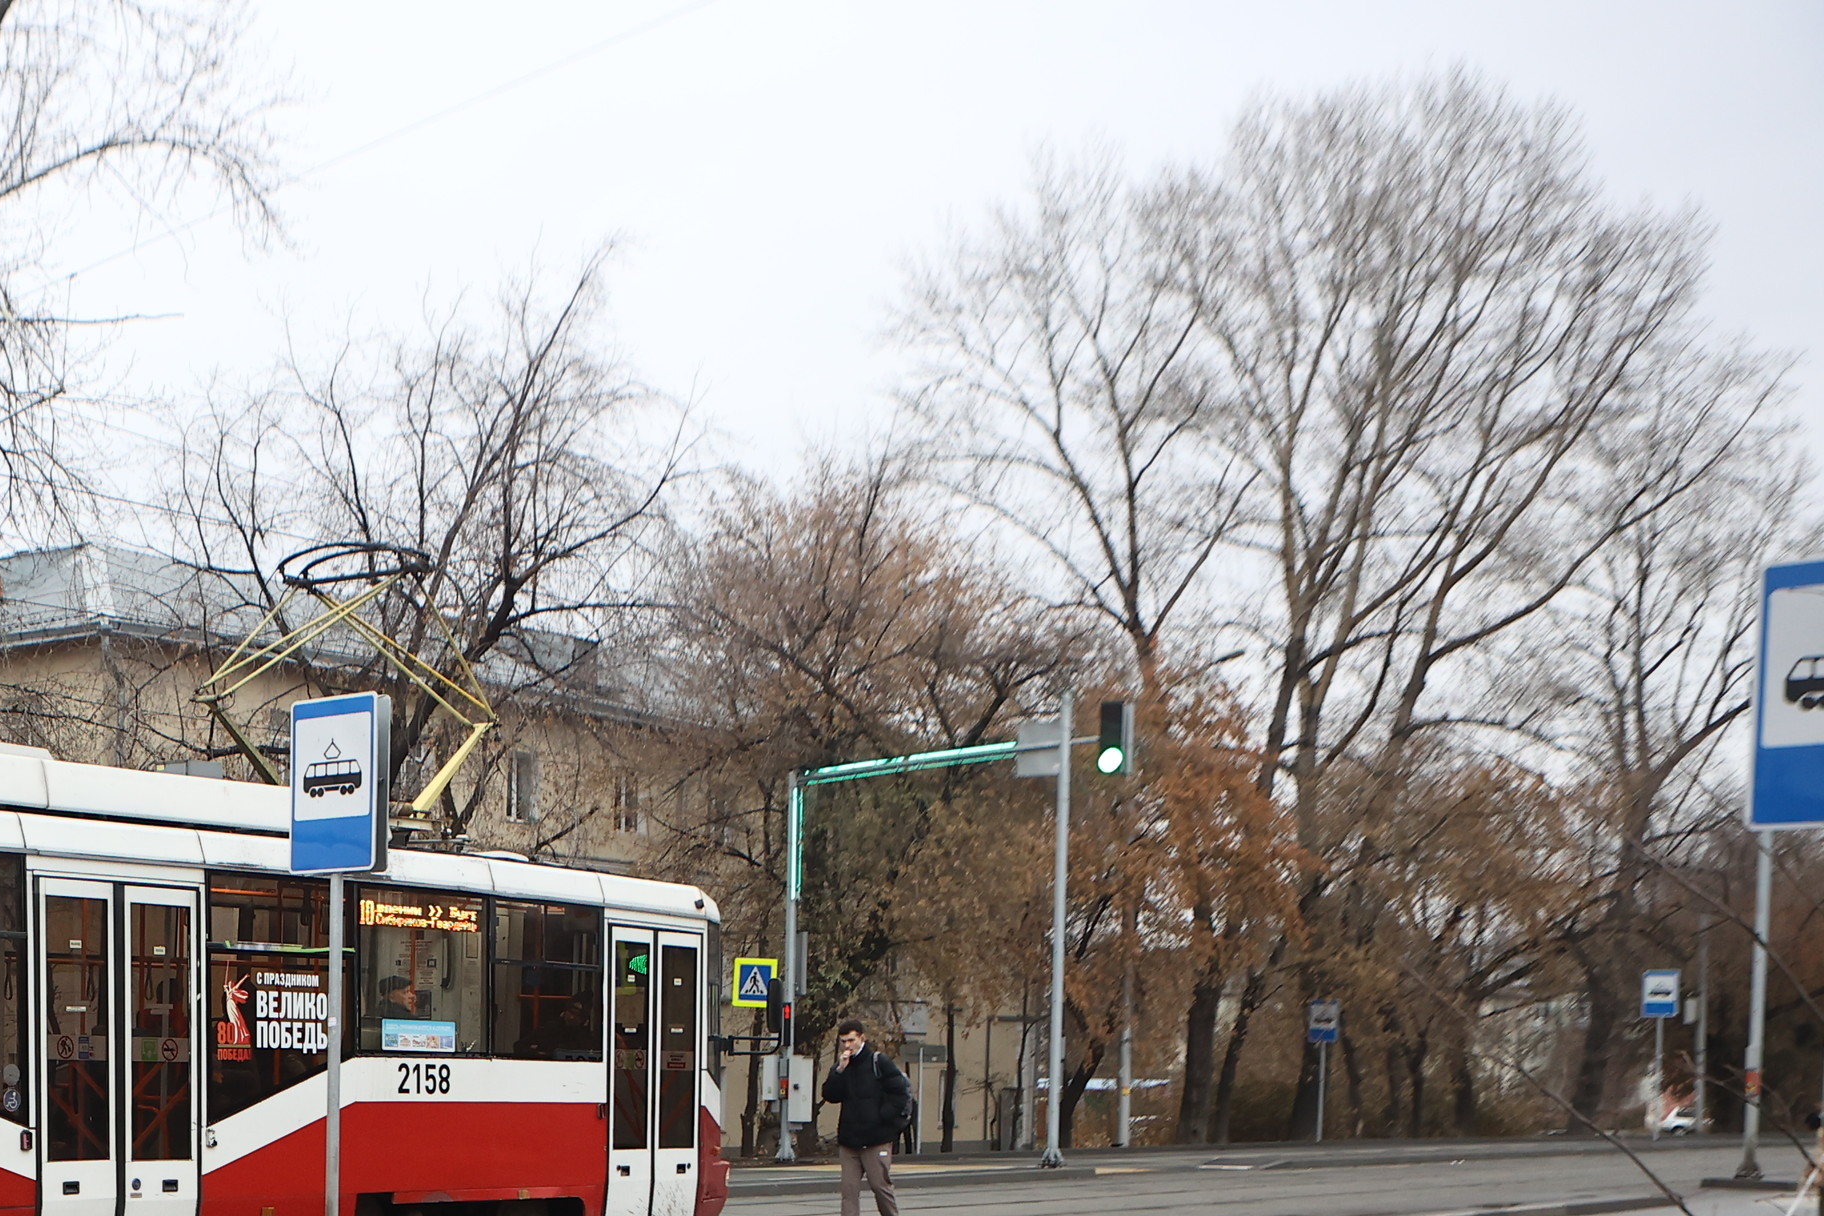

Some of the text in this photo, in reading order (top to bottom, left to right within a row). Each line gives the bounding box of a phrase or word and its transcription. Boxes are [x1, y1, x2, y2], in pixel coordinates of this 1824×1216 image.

[359, 900, 375, 925] 10
[256, 972, 319, 988] С ПРАЗДНИКОМ
[256, 990, 328, 1020] ВЕЛИКО
[217, 1021, 235, 1044] 80
[217, 1048, 251, 1062] ПОБЕДА!
[398, 1063, 450, 1094] 2158
